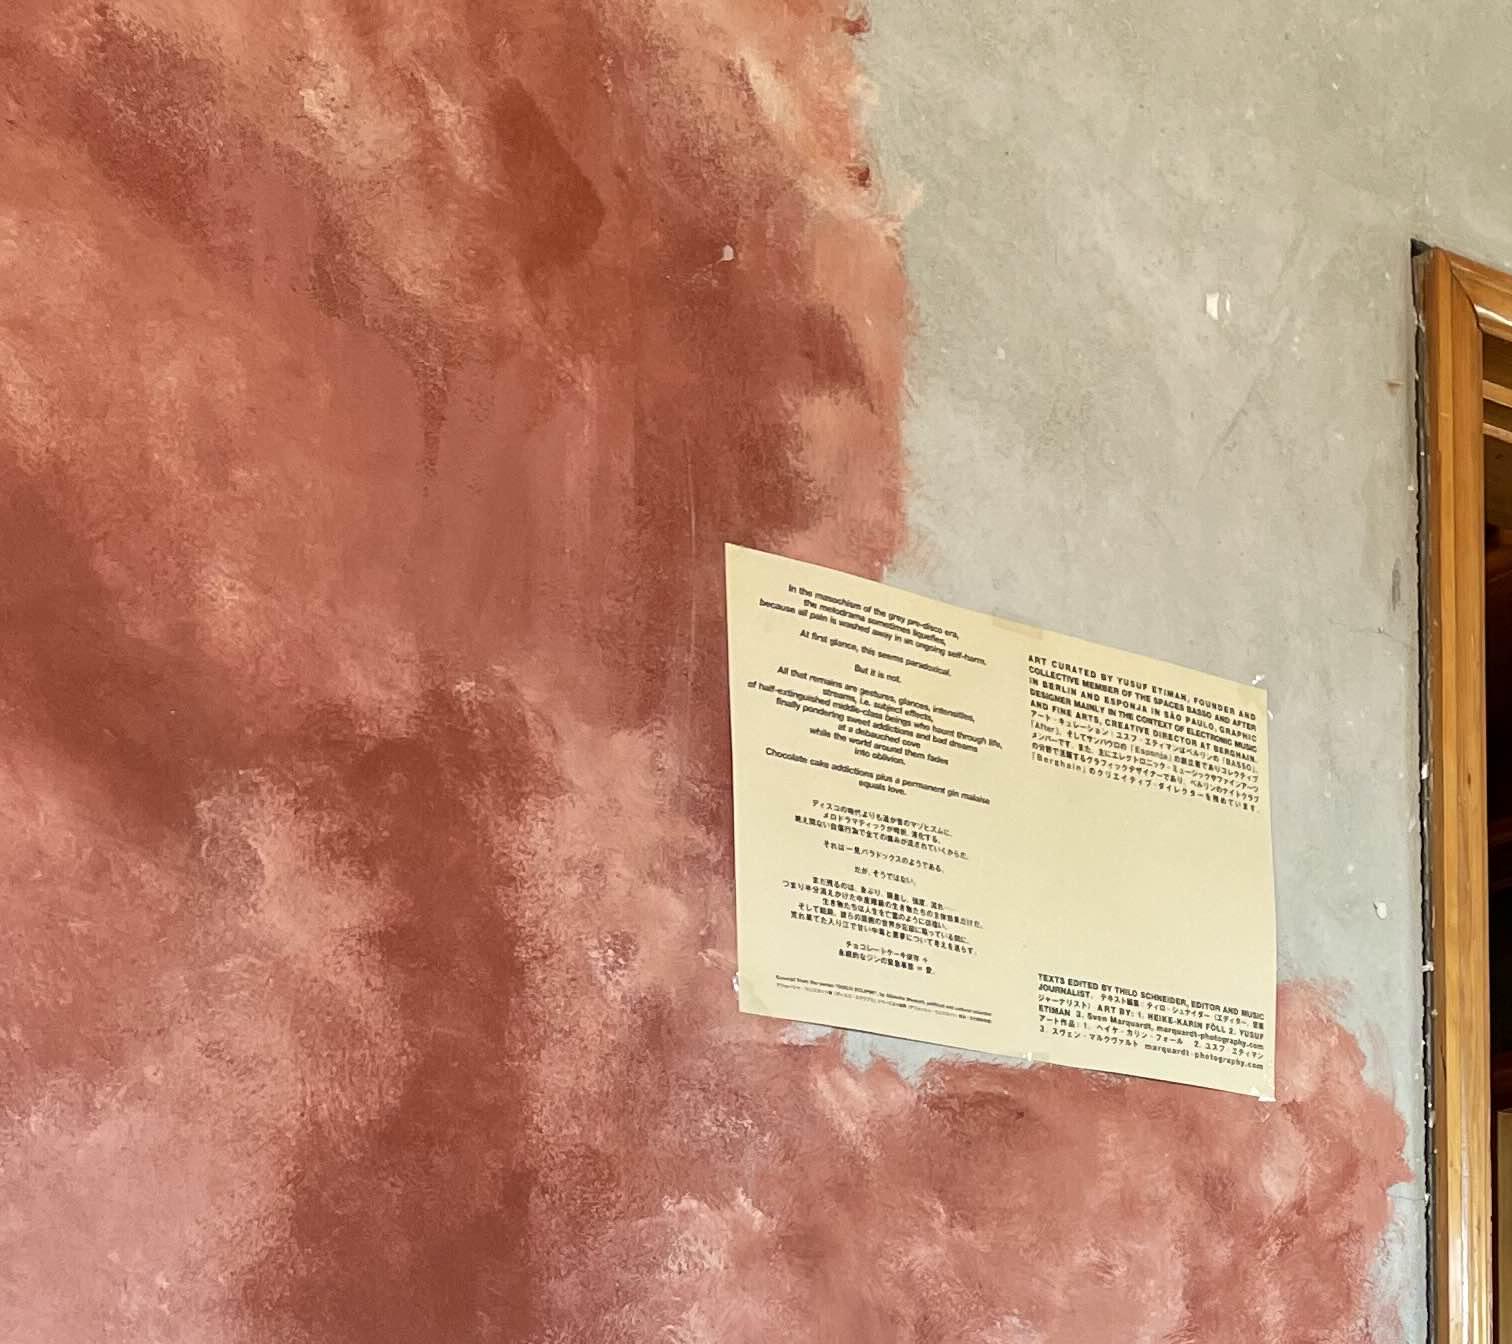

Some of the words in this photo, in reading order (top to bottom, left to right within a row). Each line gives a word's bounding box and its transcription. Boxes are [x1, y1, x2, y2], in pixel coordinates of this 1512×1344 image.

[788, 584, 797, 592] In
[798, 587, 813, 596] the
[873, 608, 886, 617] the
[854, 664, 868, 673] But
[1028, 654, 1046, 665] ART
[1051, 660, 1096, 678] CURATED
[1100, 673, 1112, 682] BY
[1117, 678, 1147, 691] YUSUF
[1151, 687, 1190, 702] ETIMAN,
[1193, 698, 1235, 714] FOUNDER
[1238, 710, 1255, 720] AND
[1028, 677, 1038, 685] IN
[1042, 680, 1076, 695] BERLIN
[1080, 690, 1100, 701] AND
[1104, 696, 1147, 713] ESPONJA
[1150, 708, 1160, 716] IN
[1163, 710, 1181, 722] SÃO
[1185, 717, 1217, 731] PAULO,
[1219, 726, 1256, 741] GRAPHIC
[1030, 700, 1048, 710] AND
[1051, 705, 1072, 716] FINE
[1075, 711, 1102, 723] ARTS,
[1104, 718, 1149, 735] CREATIVE
[1152, 730, 1197, 747] DIRECTOR
[1200, 742, 1210, 750] AT
[1096, 1004, 1116, 1013] ART
[1239, 1030, 1264, 1039] YUSUF
